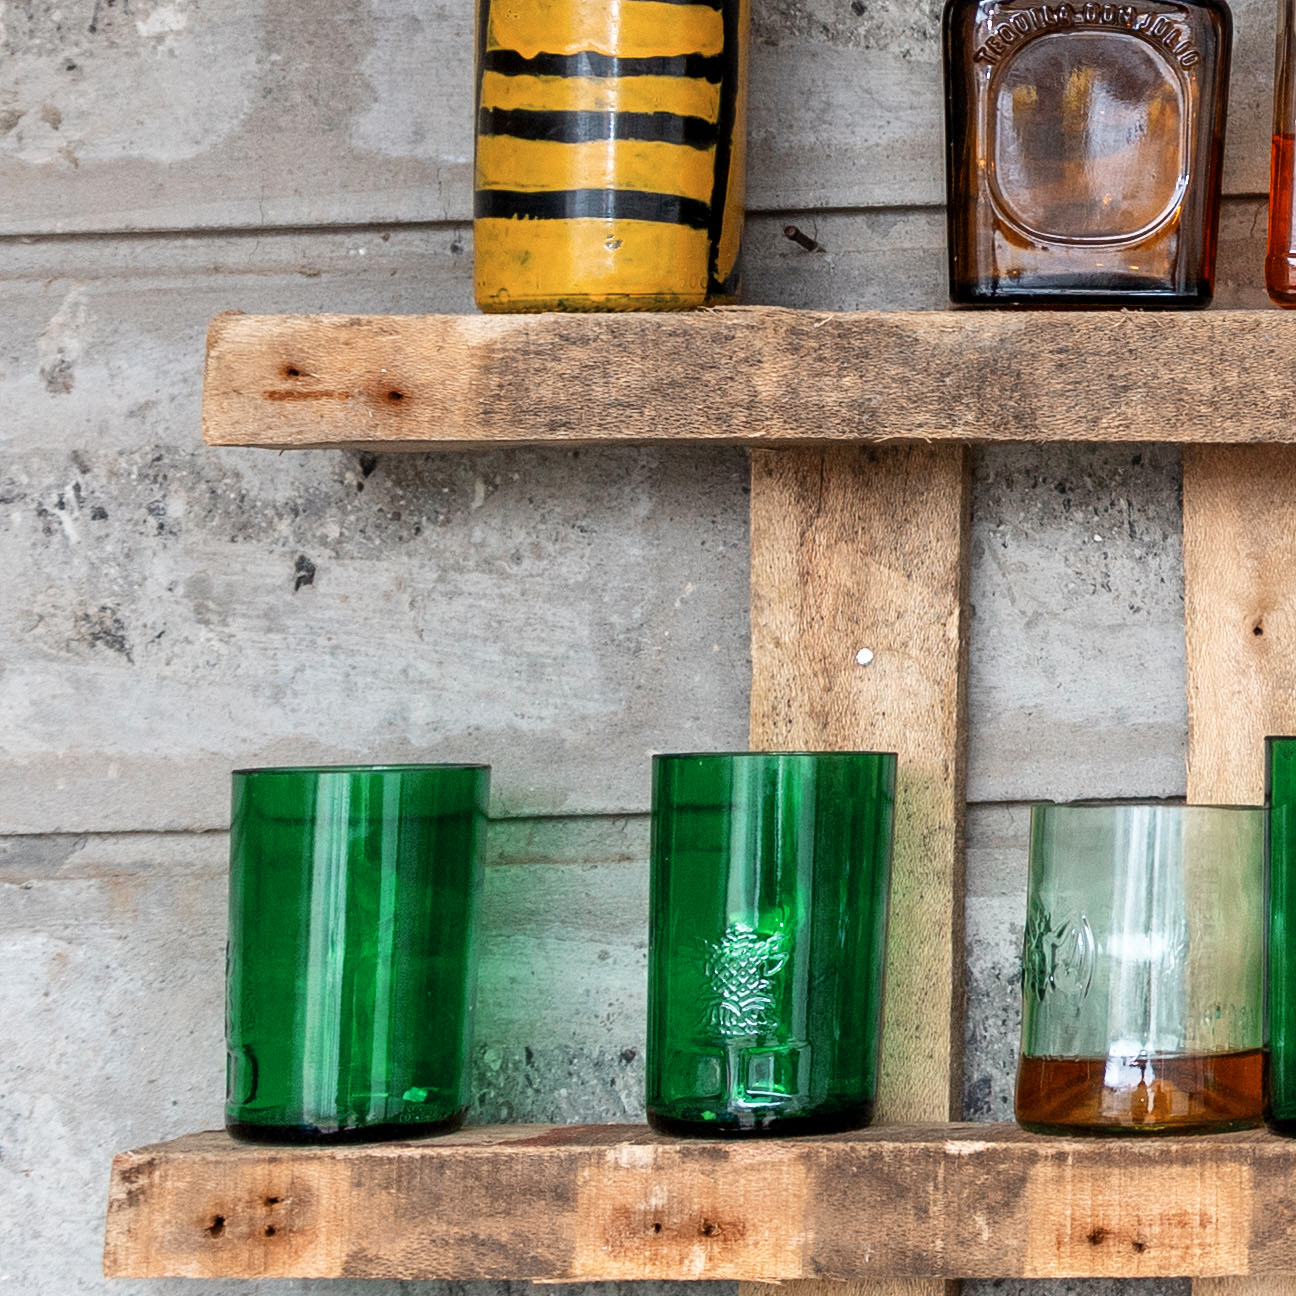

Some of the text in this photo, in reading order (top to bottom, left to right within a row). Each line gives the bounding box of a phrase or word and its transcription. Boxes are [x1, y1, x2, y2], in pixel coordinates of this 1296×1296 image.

[973, 1, 1200, 69] TEQUILA DON JULIO
